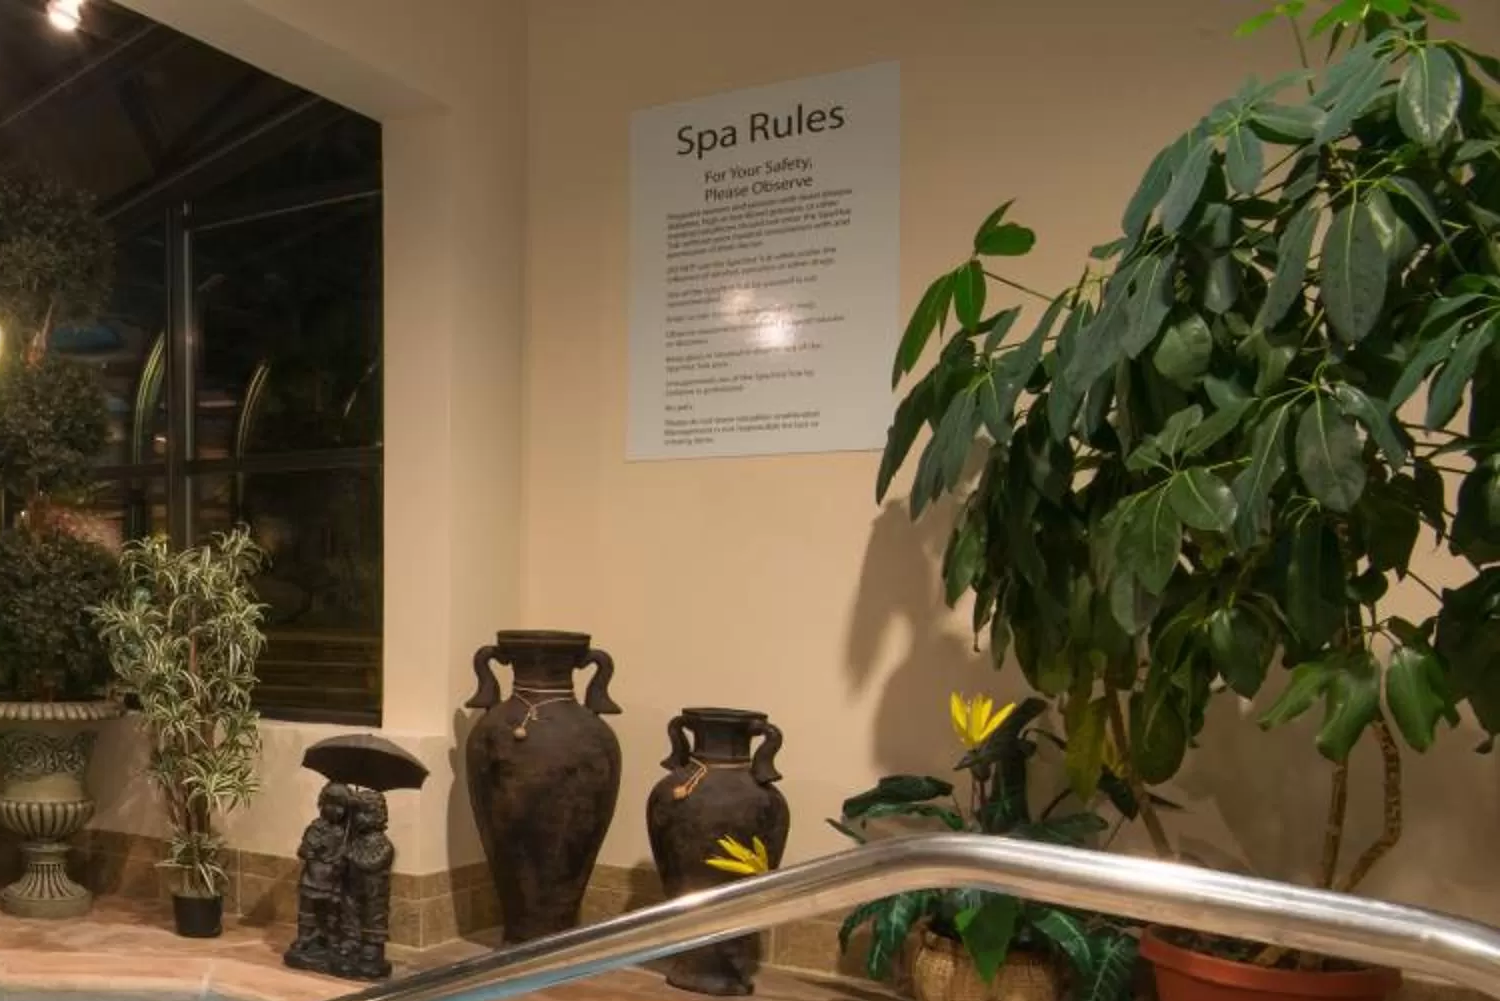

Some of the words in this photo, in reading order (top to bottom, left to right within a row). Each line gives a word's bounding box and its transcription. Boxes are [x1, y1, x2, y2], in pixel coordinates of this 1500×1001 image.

[677, 124, 738, 160] Spa
[750, 103, 846, 143] Rules
[704, 170, 727, 184] For
[729, 163, 762, 178] Your
[704, 185, 749, 202] Please
[751, 176, 813, 195] Observe
